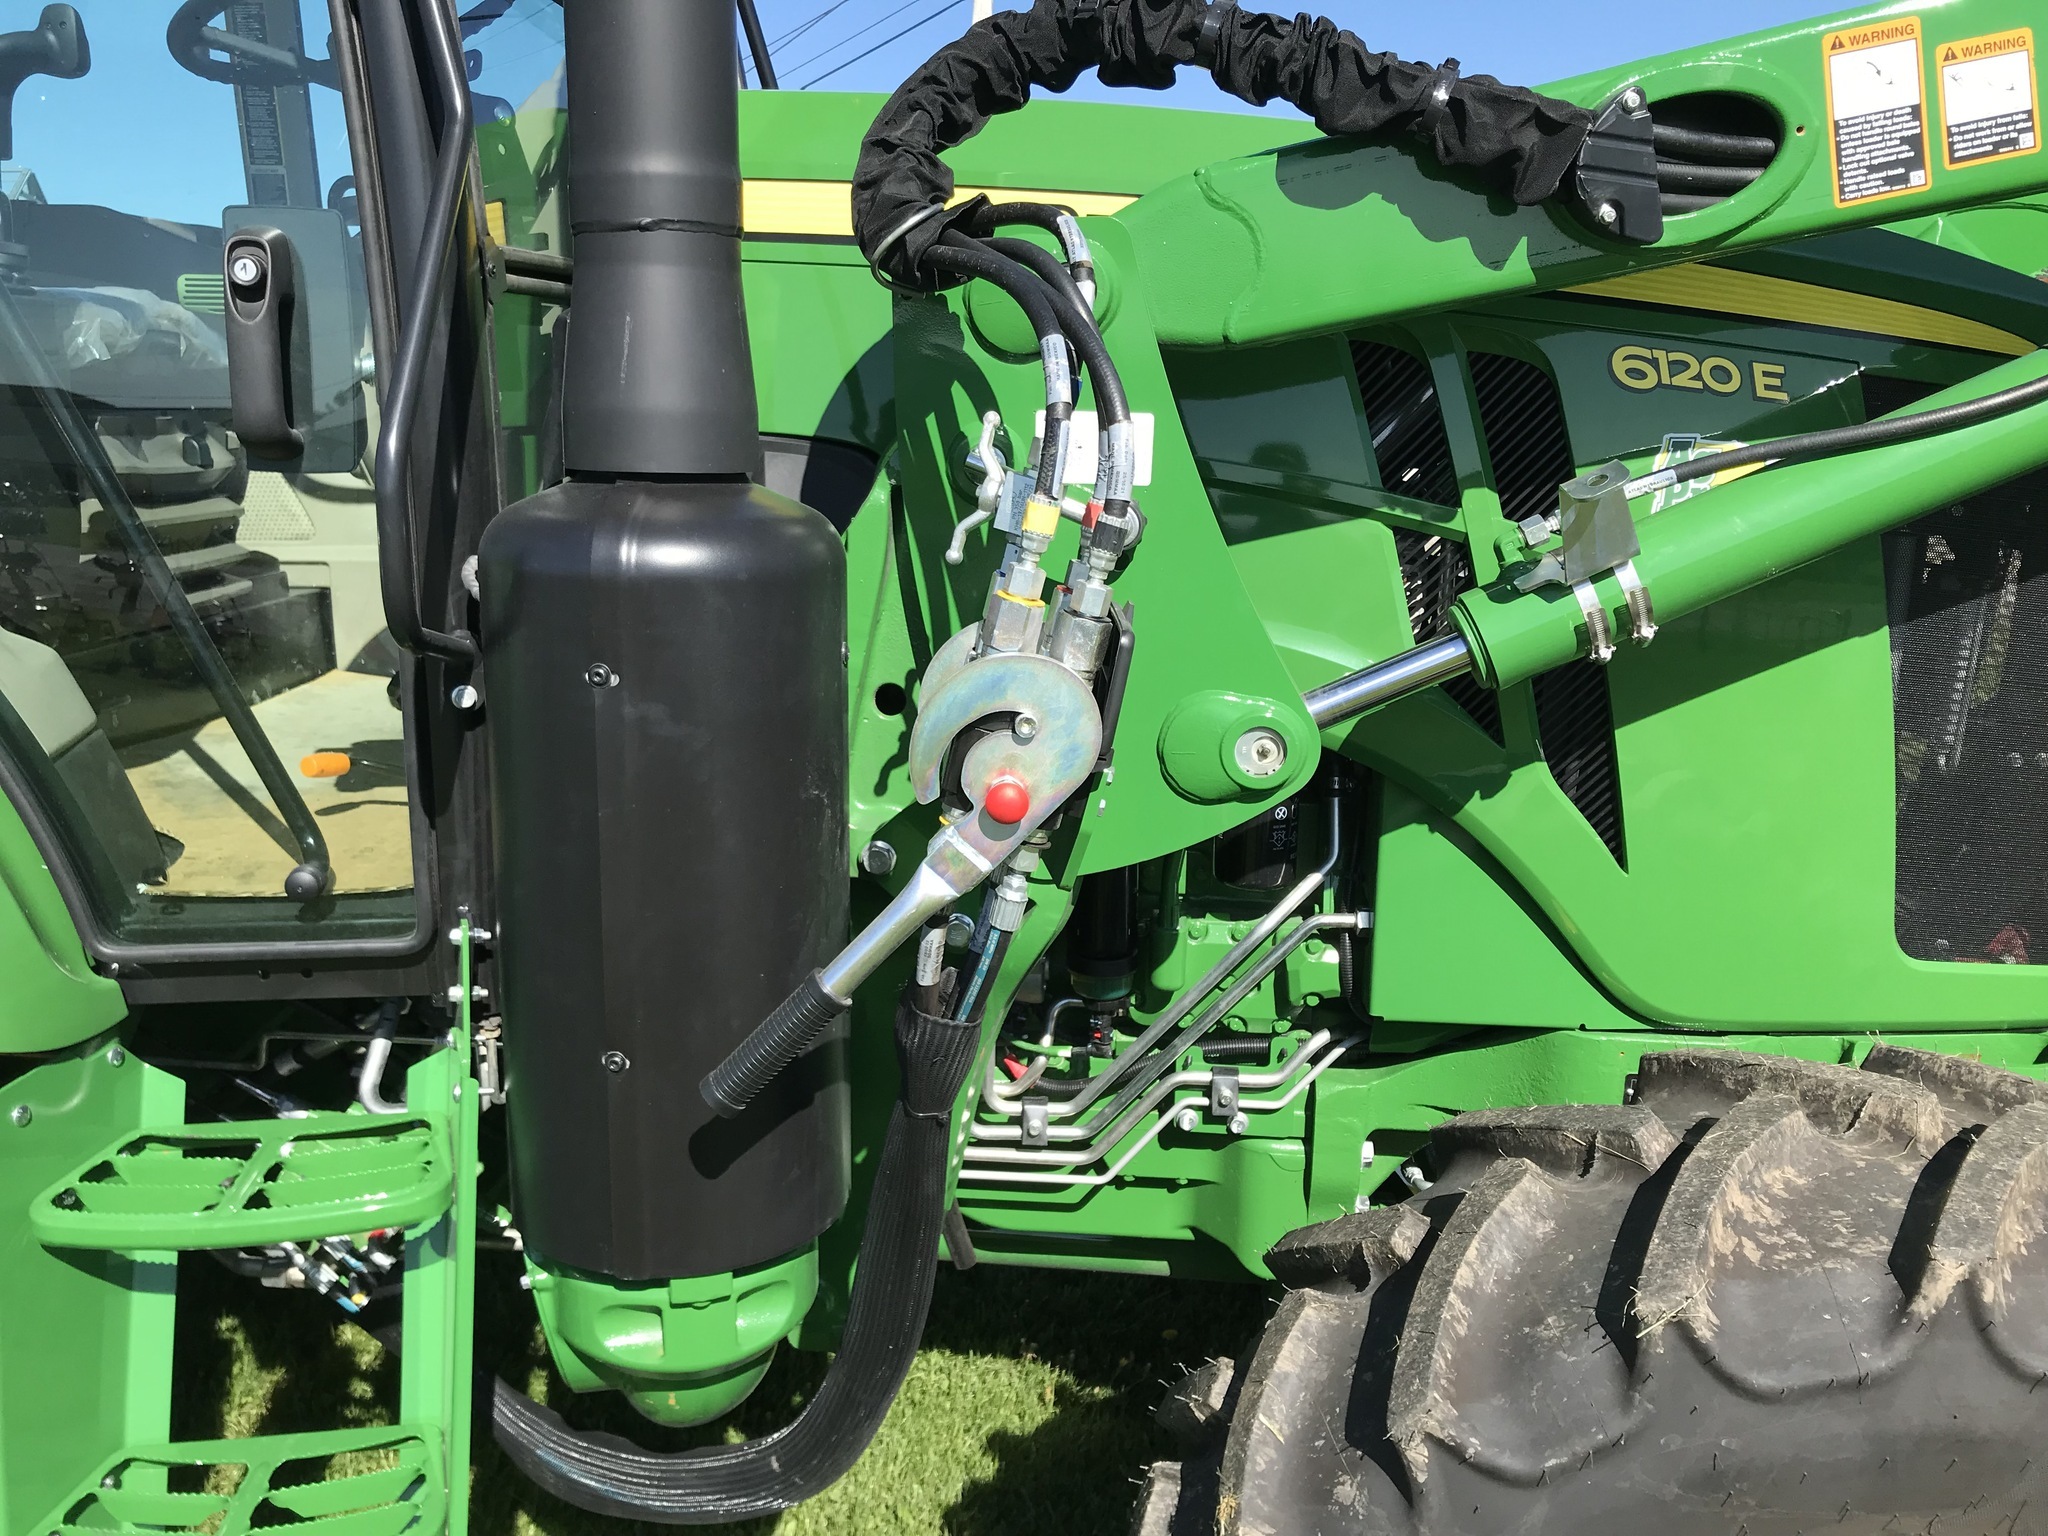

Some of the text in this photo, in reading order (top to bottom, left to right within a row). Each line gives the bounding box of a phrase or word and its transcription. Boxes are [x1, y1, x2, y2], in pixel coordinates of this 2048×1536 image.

[1848, 24, 1915, 47] WARNING
[1961, 36, 2027, 58] WARNING
[1608, 344, 1790, 404] 6120 E
